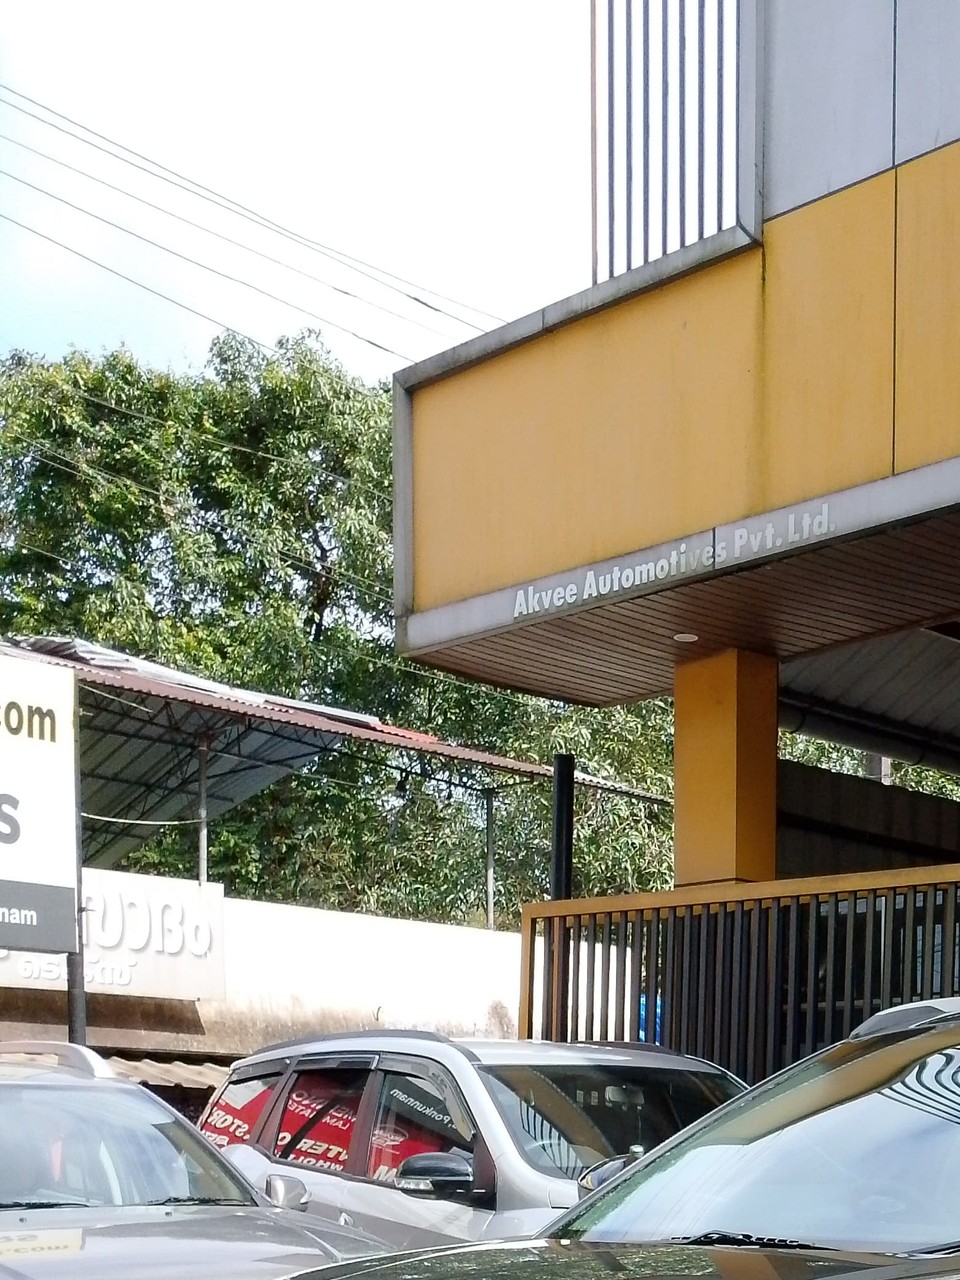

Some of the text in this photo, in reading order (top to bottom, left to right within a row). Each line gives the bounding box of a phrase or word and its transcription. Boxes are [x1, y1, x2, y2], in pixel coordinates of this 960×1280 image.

[513, 503, 836, 617] Akvee Automotives Pvt. Ltd.
